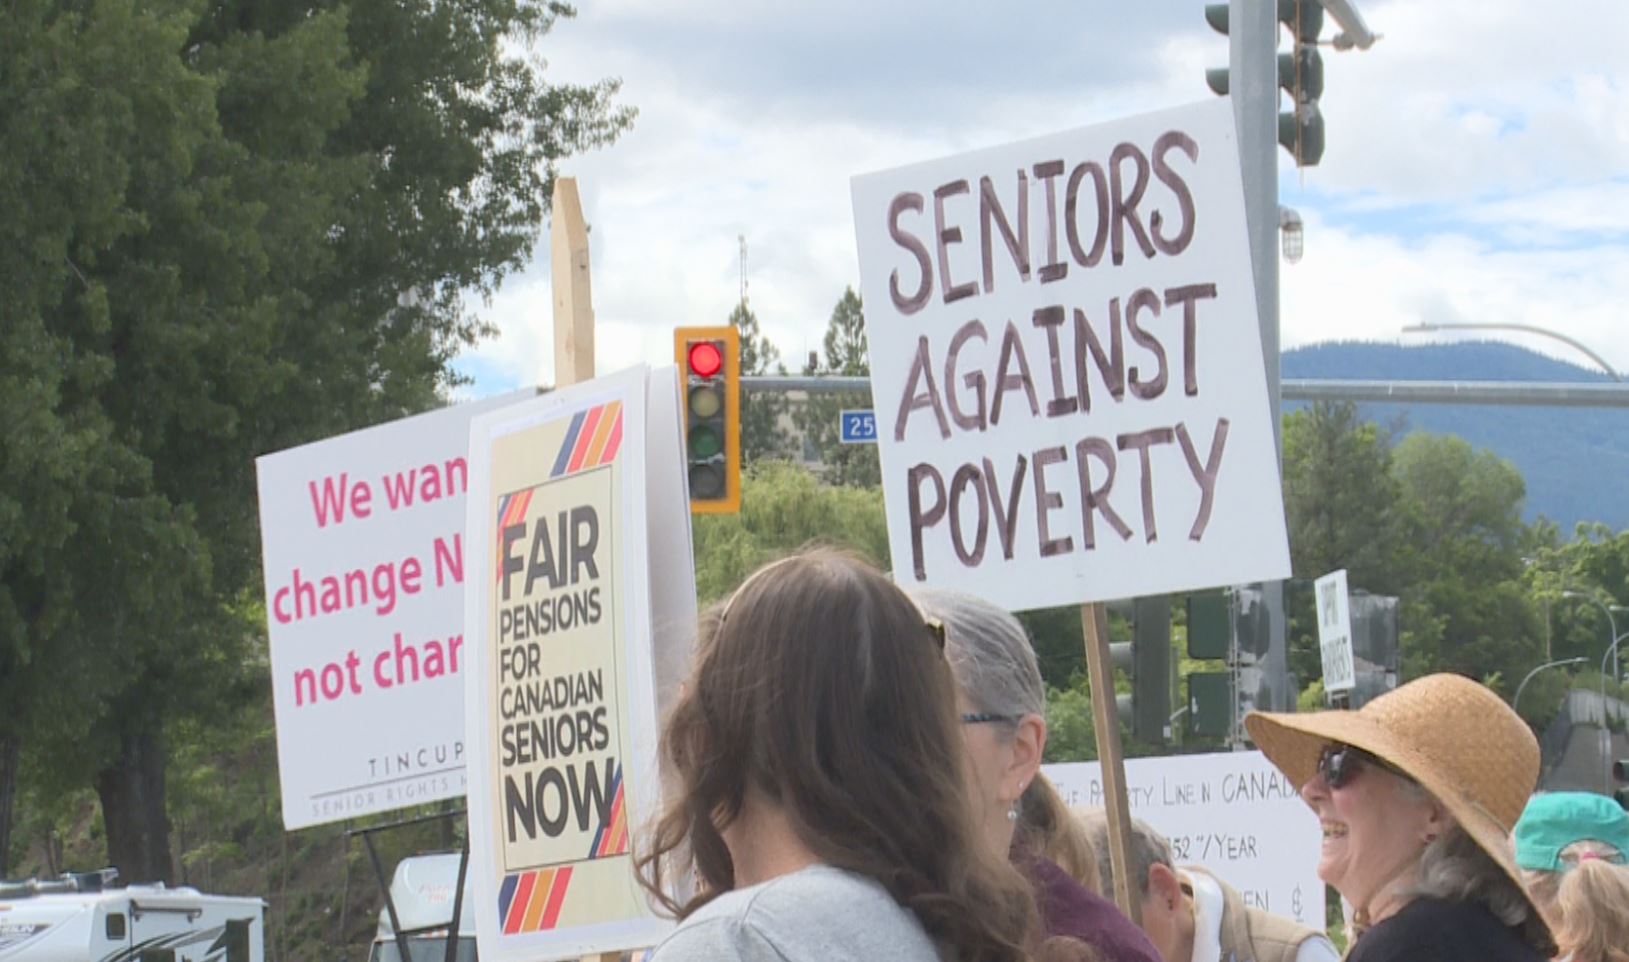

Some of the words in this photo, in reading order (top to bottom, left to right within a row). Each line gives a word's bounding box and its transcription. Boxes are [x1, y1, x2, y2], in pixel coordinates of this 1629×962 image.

[887, 130, 1199, 316] SENIORS
[893, 282, 1218, 443] AGAINST
[850, 416, 874, 436] 25
[308, 472, 372, 529] We
[382, 456, 468, 511] wan
[907, 417, 1230, 582] POVERTY
[502, 503, 600, 602] FAIR
[272, 556, 423, 625] change
[500, 586, 603, 645] PENSIONS
[294, 650, 363, 708] not
[500, 642, 542, 684] FOR
[500, 667, 604, 721] CANADIAN
[367, 741, 465, 779] TINCUP
[501, 706, 610, 768] SENIORS
[311, 792, 375, 818] SENIOR
[386, 776, 449, 801] RIGHTS
[504, 756, 615, 844] NOW
